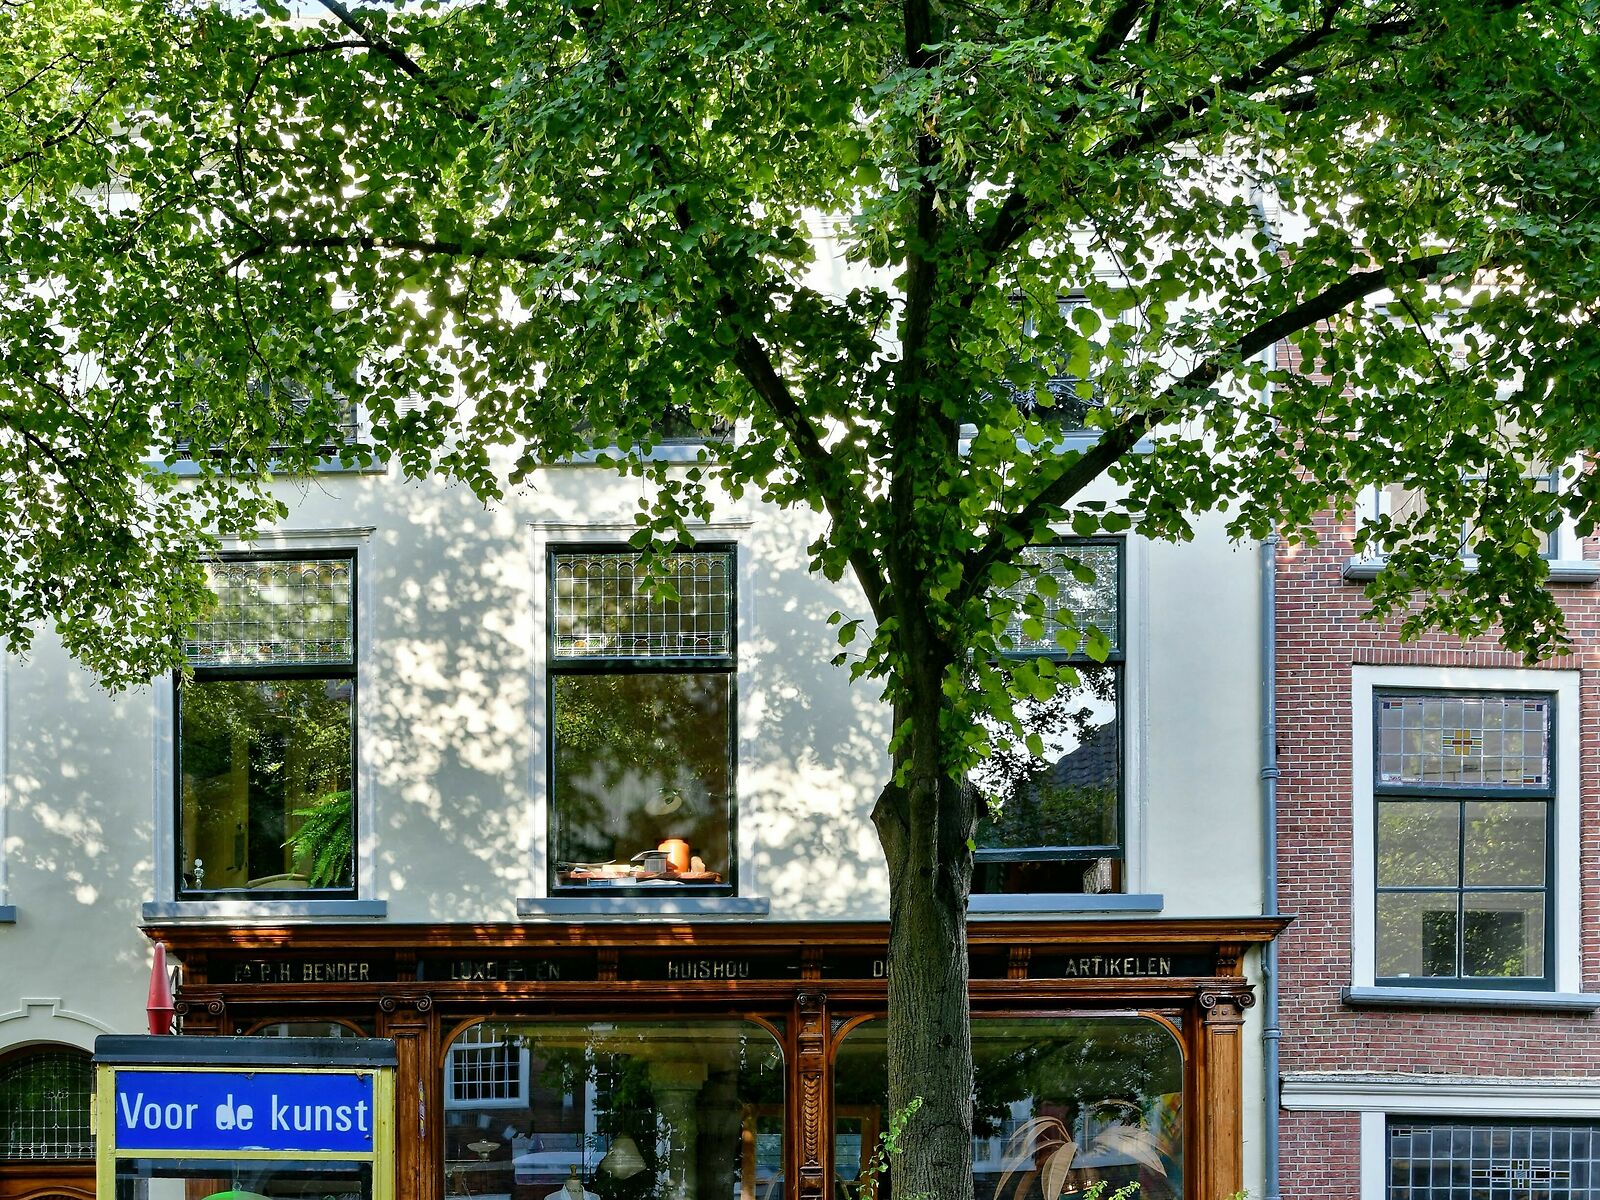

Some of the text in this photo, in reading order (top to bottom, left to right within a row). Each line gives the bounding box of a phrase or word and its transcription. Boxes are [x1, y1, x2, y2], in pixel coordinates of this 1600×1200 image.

[303, 962, 369, 981] BENDER
[668, 960, 749, 979] HUISHOU
[1065, 957, 1171, 976] ARTIKELEN
[120, 1092, 368, 1132] Voor de kunst
